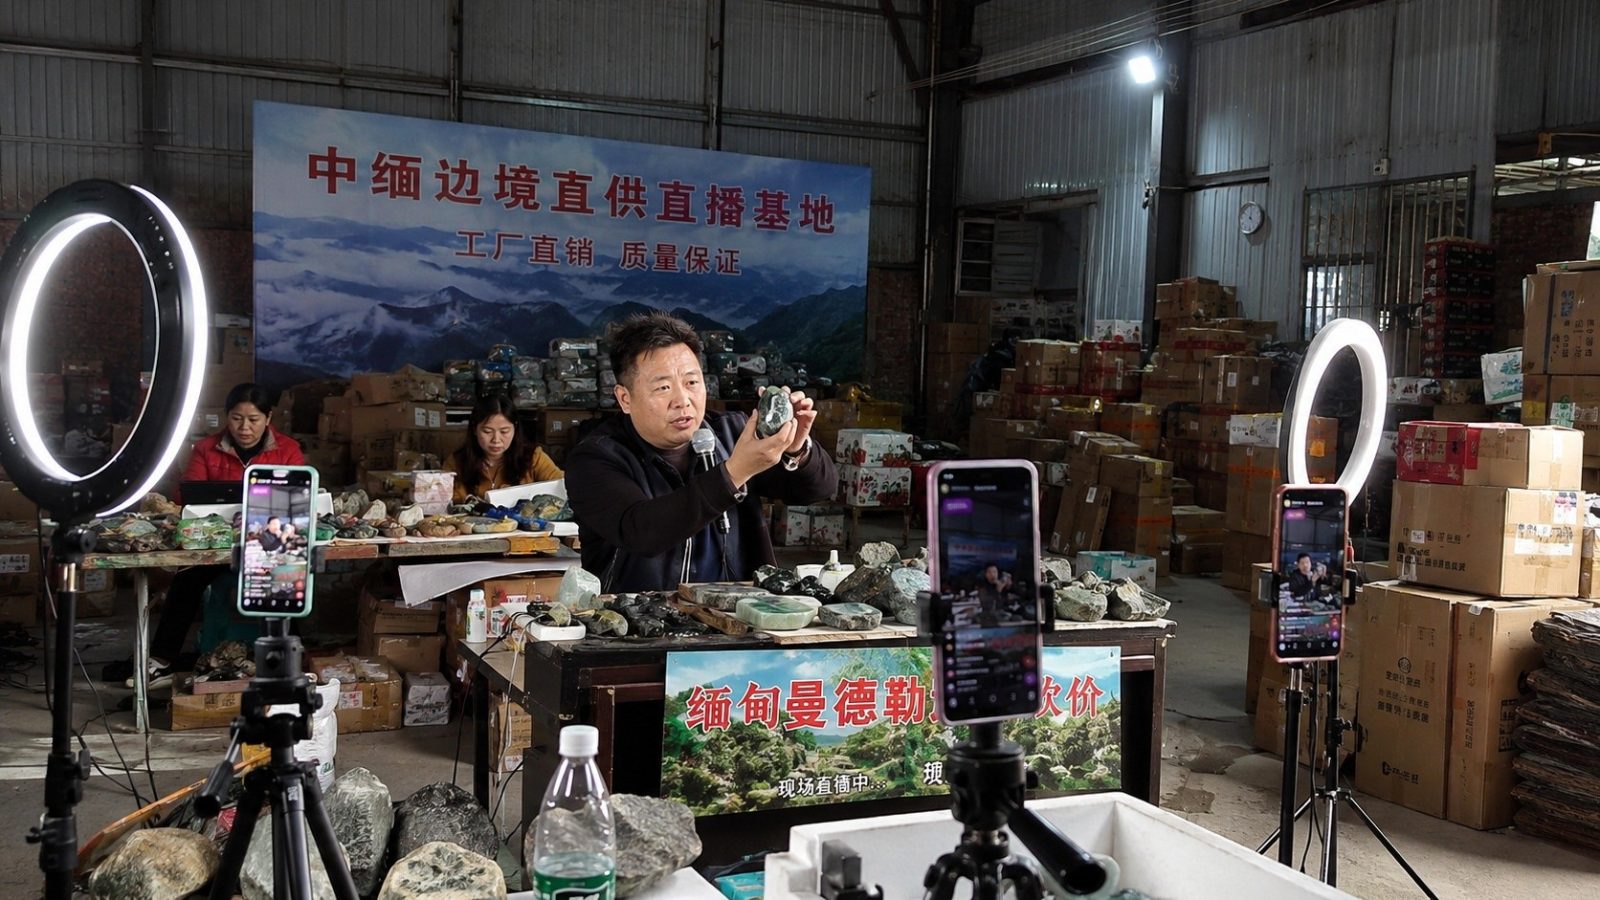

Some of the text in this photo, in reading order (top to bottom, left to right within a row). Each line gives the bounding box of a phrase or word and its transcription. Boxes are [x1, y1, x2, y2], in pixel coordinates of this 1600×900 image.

[307, 145, 836, 235] 中缅边境直供直播基地
[454, 230, 742, 275] 工厂直销 质量保证
